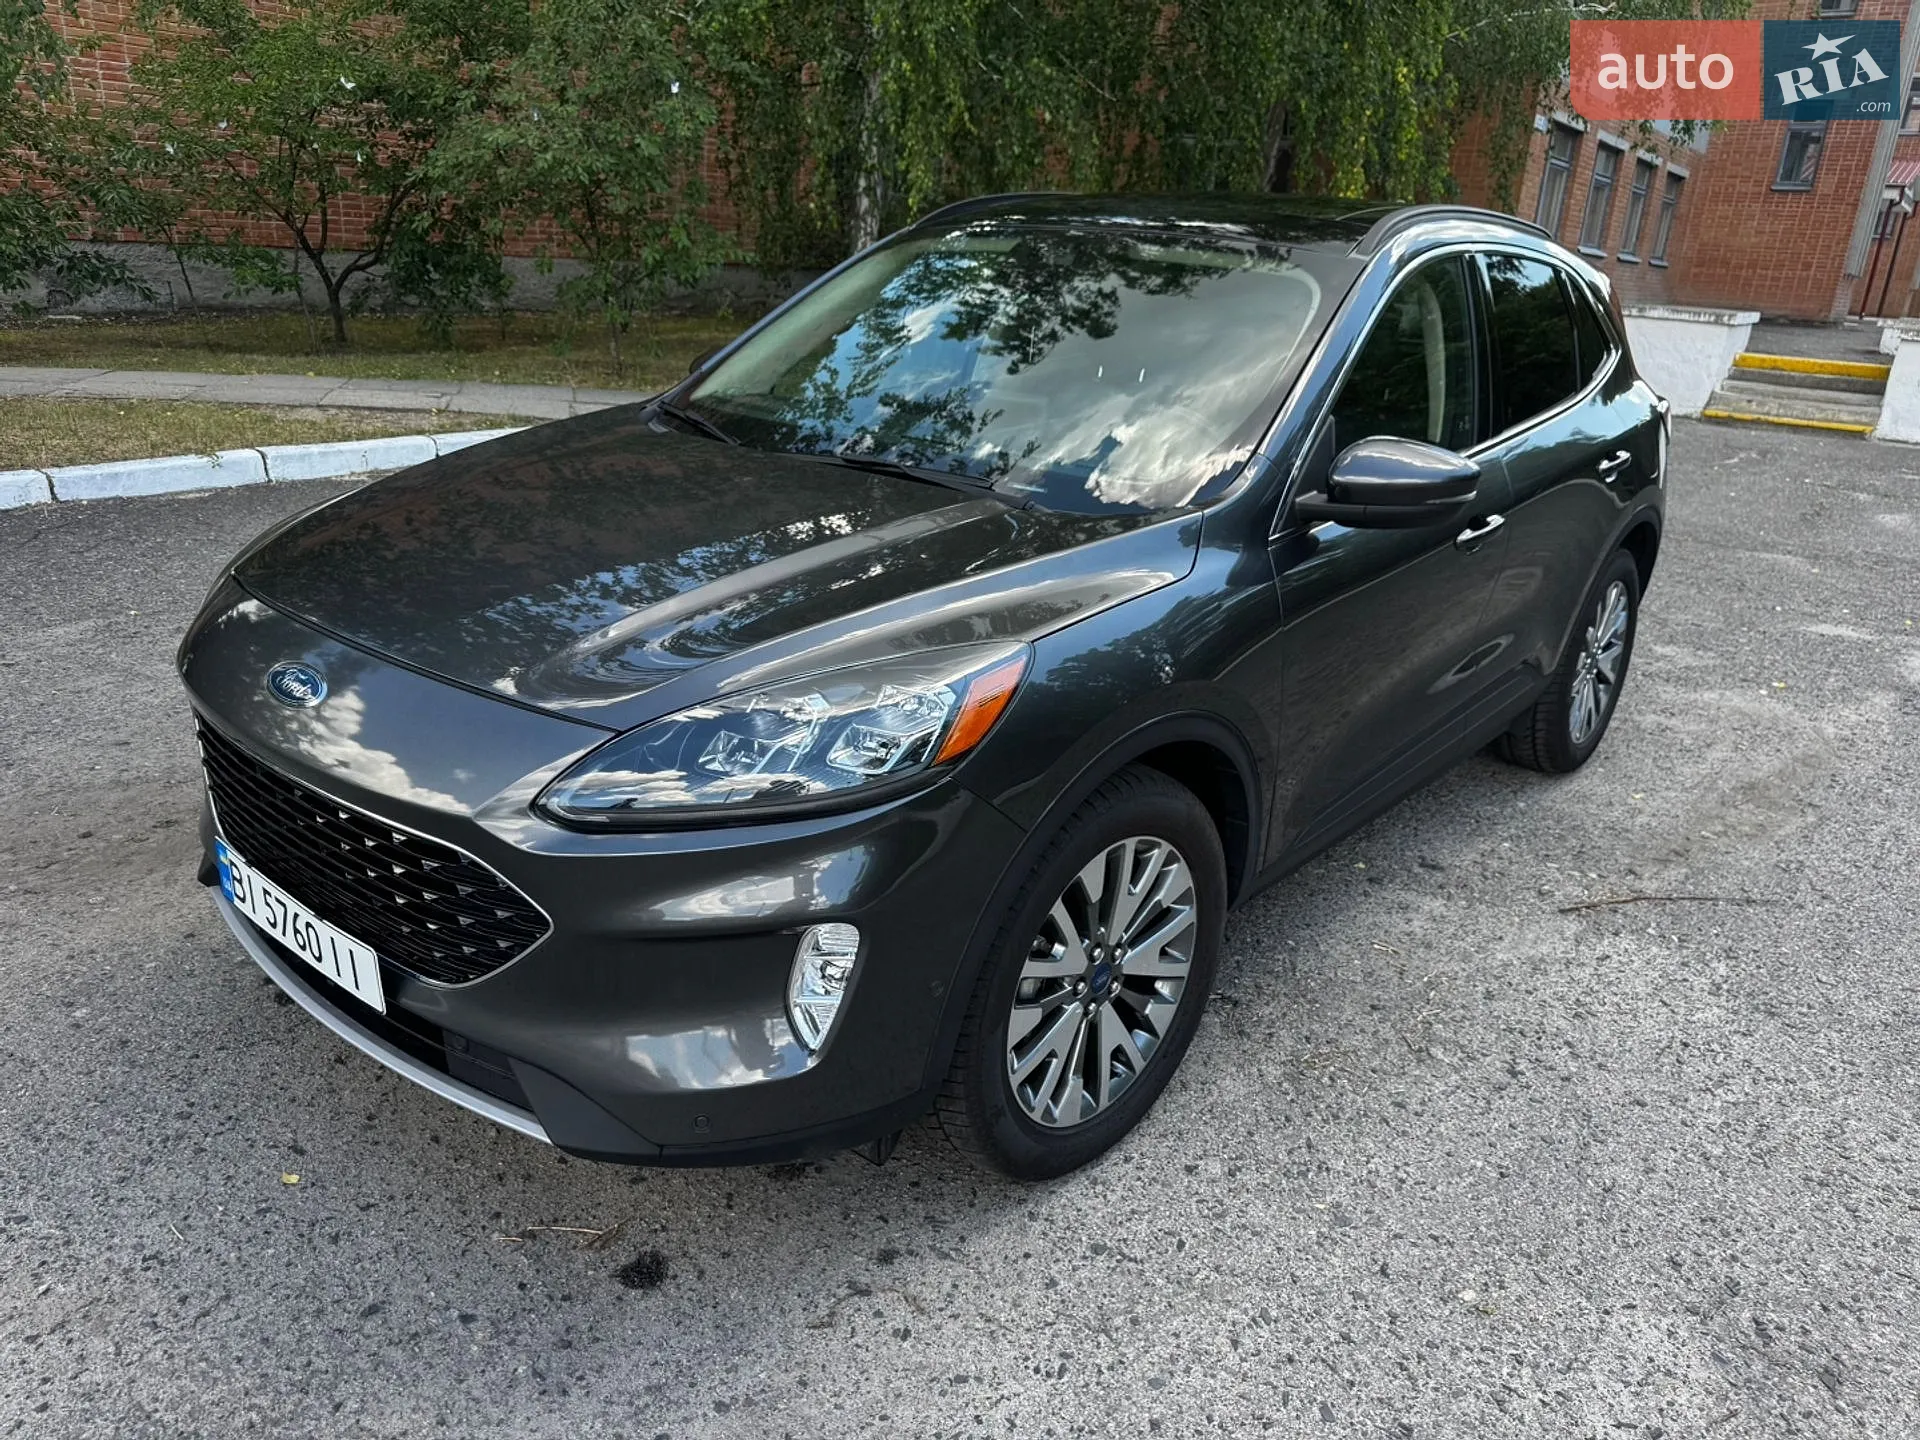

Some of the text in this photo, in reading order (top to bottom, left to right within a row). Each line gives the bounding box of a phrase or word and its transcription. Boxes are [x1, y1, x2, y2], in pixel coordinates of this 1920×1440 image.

[276, 668, 314, 699] Ford
[230, 859, 359, 990] BI 5760 II
